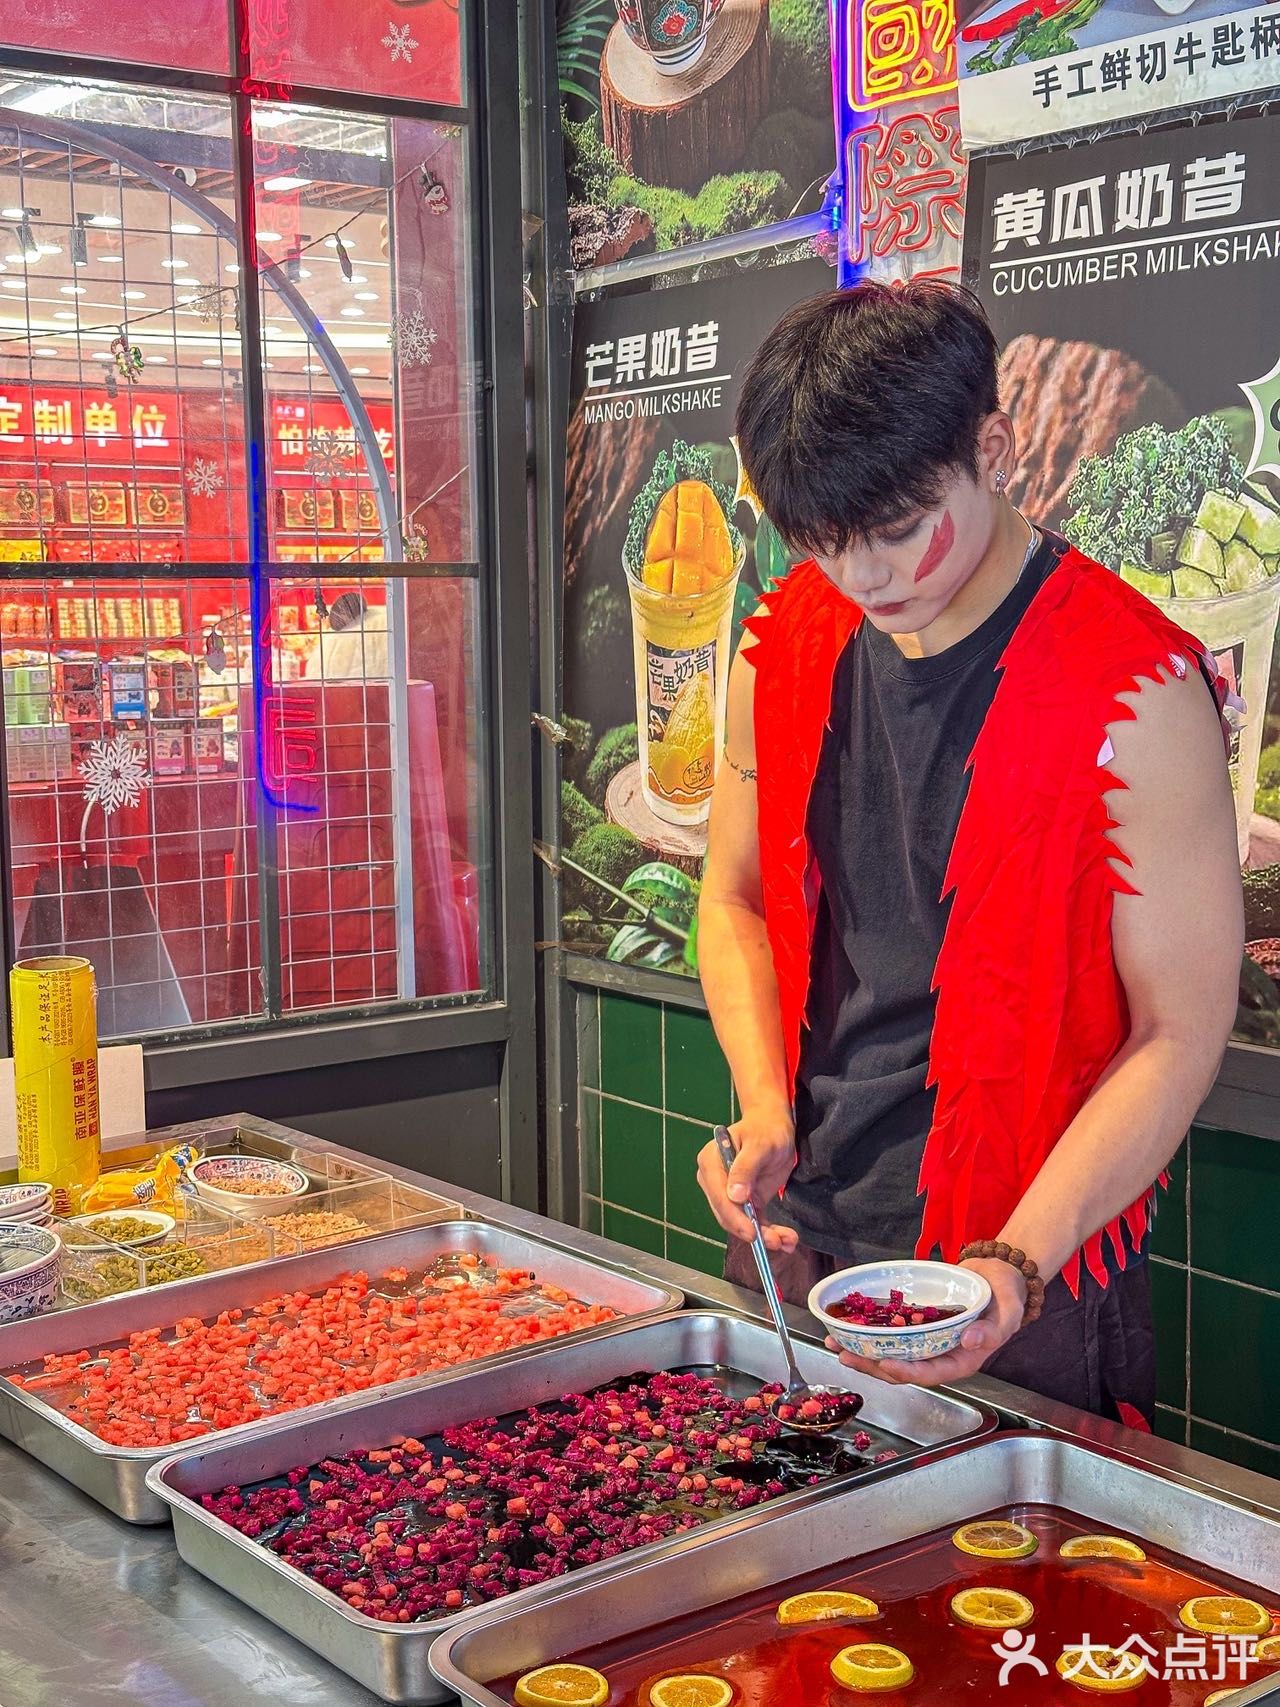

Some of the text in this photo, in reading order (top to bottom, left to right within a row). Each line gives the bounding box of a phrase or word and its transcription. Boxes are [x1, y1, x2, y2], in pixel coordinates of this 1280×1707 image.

[1032, 16, 1280, 108] 手工鲜切牛匙柄
[990, 151, 1246, 253] 黄瓜奶昔
[992, 252, 1138, 297] CUCUMBER
[584, 320, 719, 388] 芒果奶昔
[584, 386, 722, 425] MANGO MILKSHAKE
[649, 650, 712, 701] 芒果奶昔
[72, 1060, 87, 1141] 南亚保鲜膜
[86, 1058, 97, 1120] NAN YA WRAP
[55, 1188, 71, 1215] WRAP
